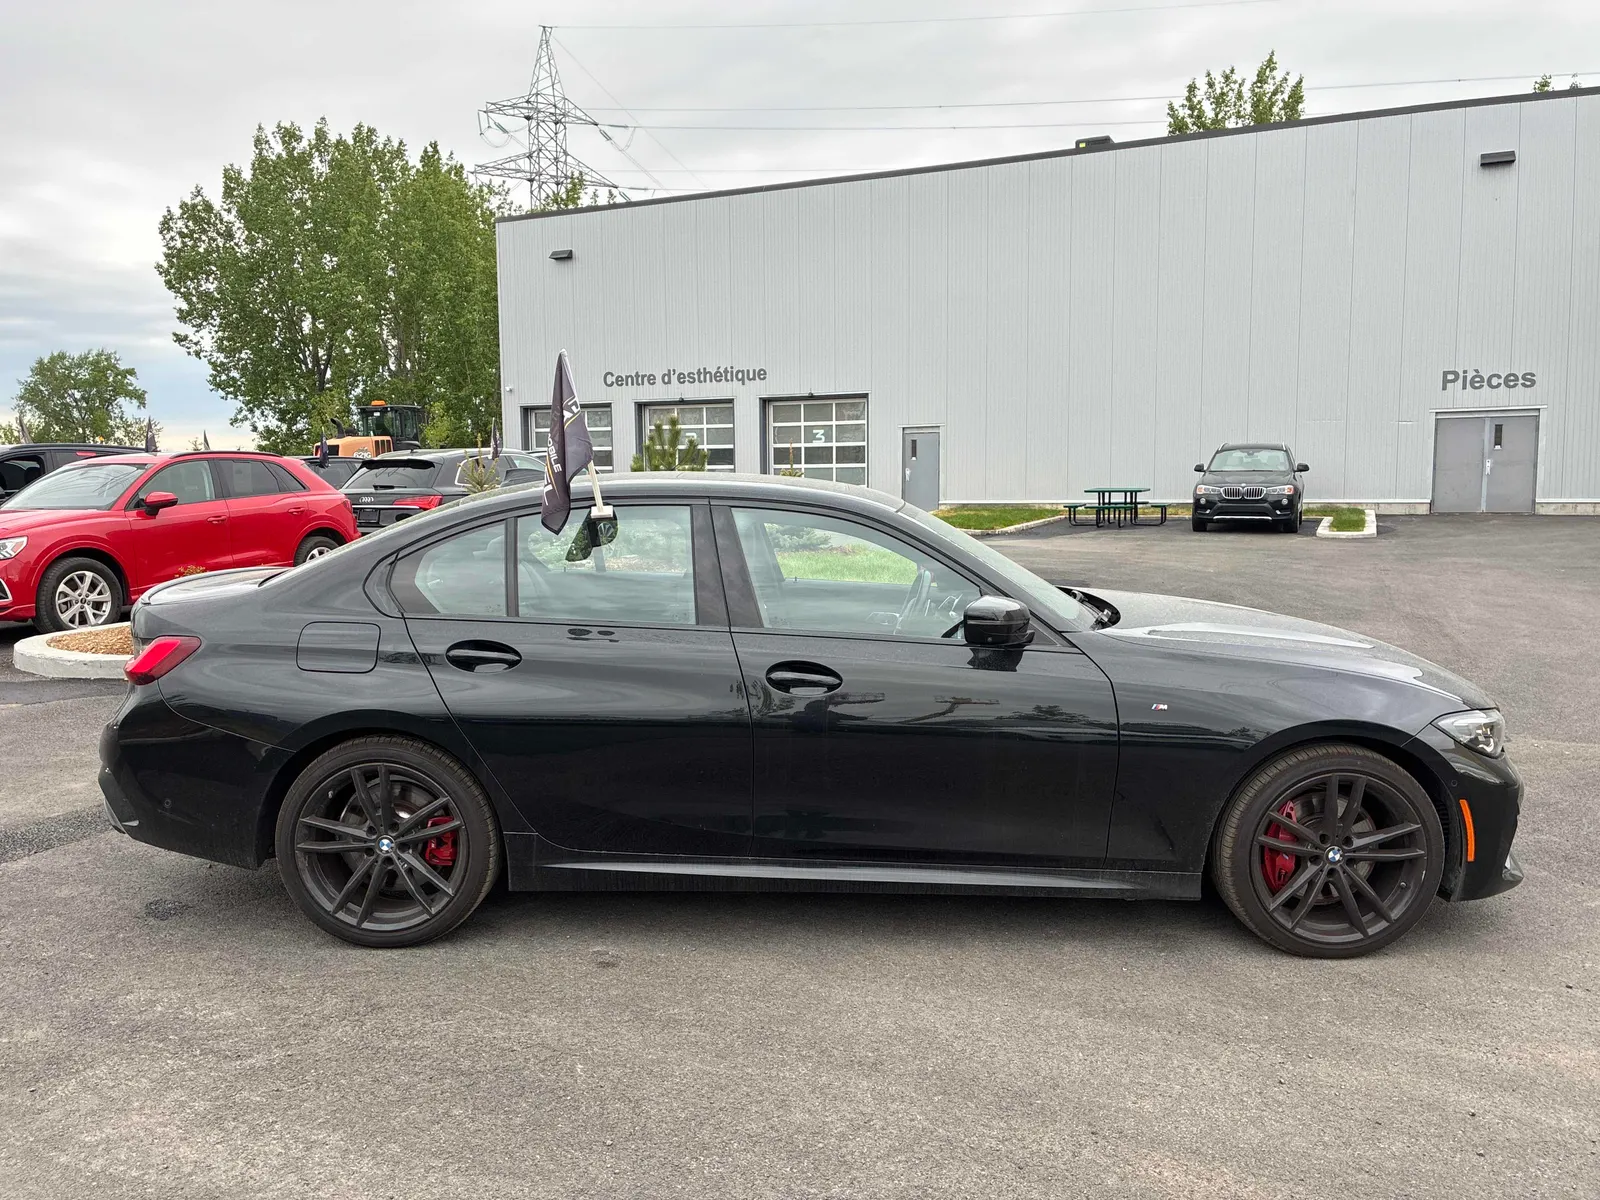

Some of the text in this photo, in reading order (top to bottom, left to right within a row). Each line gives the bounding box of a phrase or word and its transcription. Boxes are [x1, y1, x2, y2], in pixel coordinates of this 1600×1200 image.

[603, 365, 767, 387] Centre d’esthétique
[1441, 368, 1536, 390] Pièces
[812, 429, 826, 444] 3
